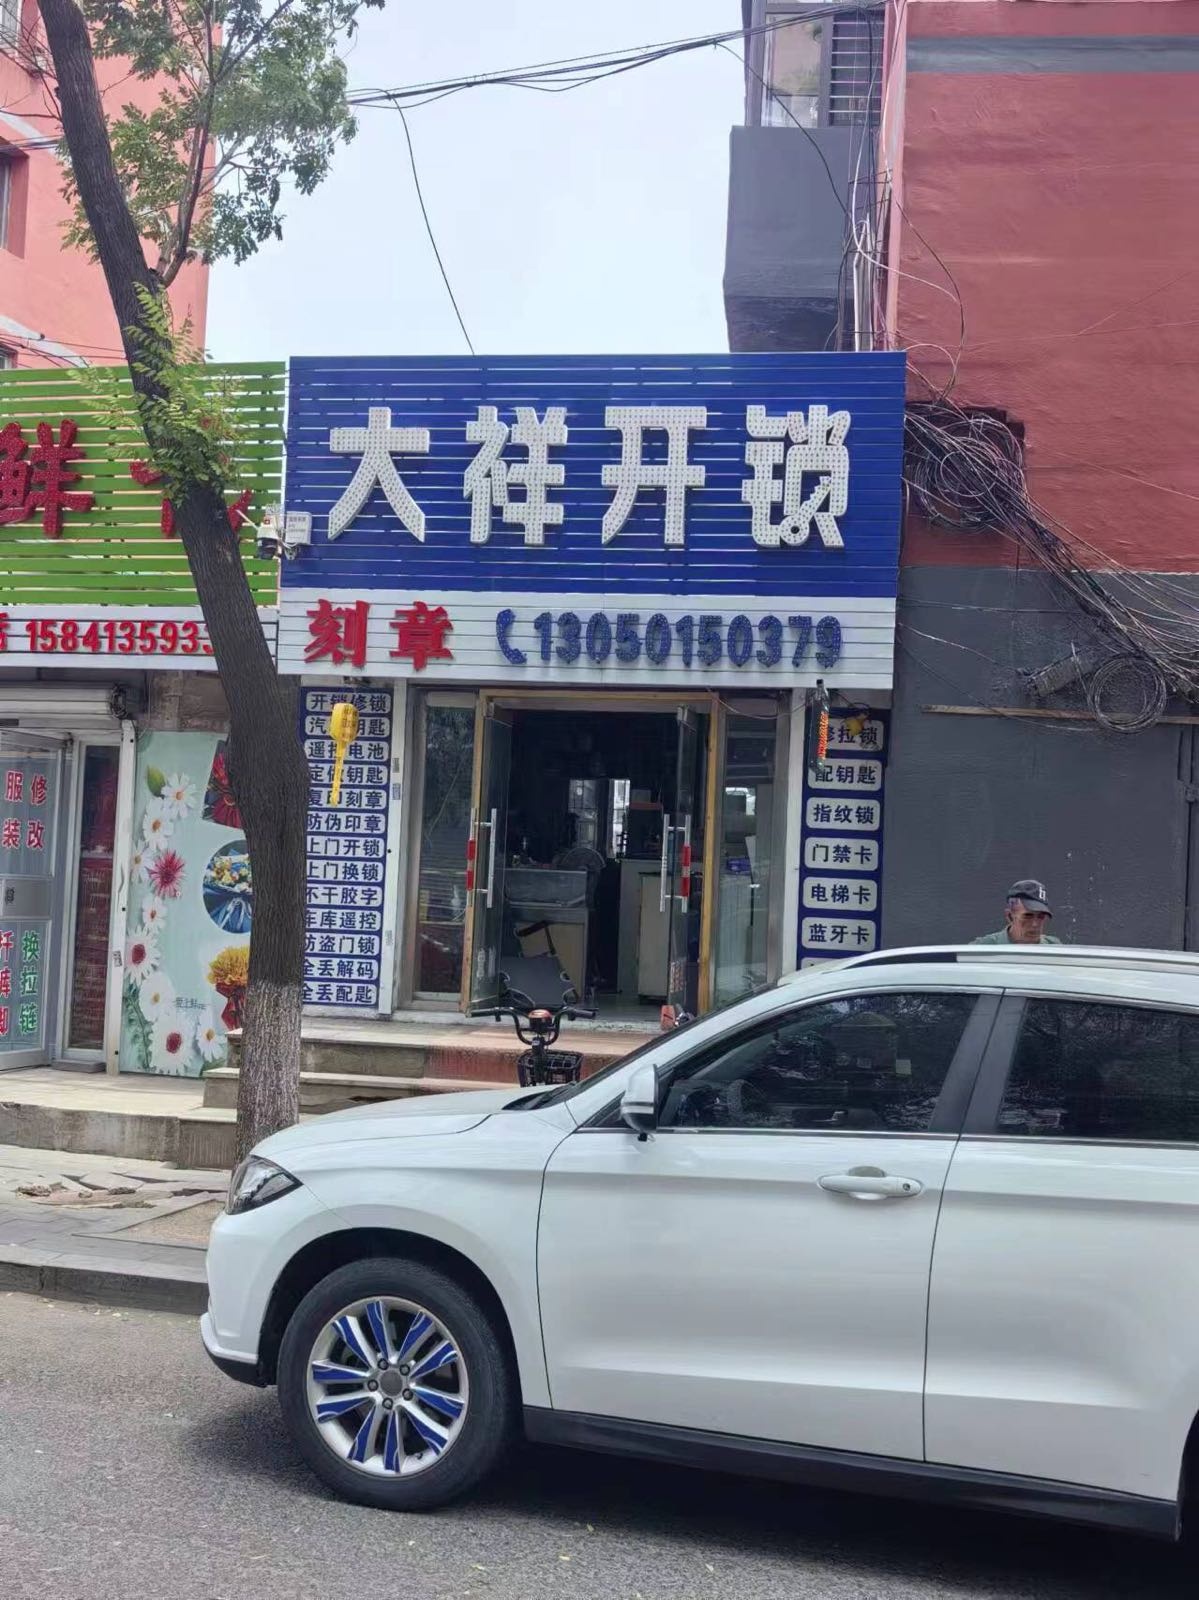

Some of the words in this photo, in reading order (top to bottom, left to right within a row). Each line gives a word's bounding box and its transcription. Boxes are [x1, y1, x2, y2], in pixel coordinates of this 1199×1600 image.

[328, 405, 850, 547] 大祥开锁
[305, 599, 454, 671] 刻章
[534, 611, 842, 668] 13050150379
[815, 765, 876, 785] 配钥匙
[307, 813, 382, 833] 防伪印章
[813, 804, 874, 825] 指纹锁
[307, 838, 380, 857] 上门开锁
[812, 844, 872, 864] 门禁卡
[306, 861, 379, 881] 上门换锁
[305, 886, 378, 906] 不干胶字
[811, 884, 871, 905] 电梯卡
[808, 924, 870, 945] 蓝牙卡
[20, 931, 39, 1033] 换拉链
